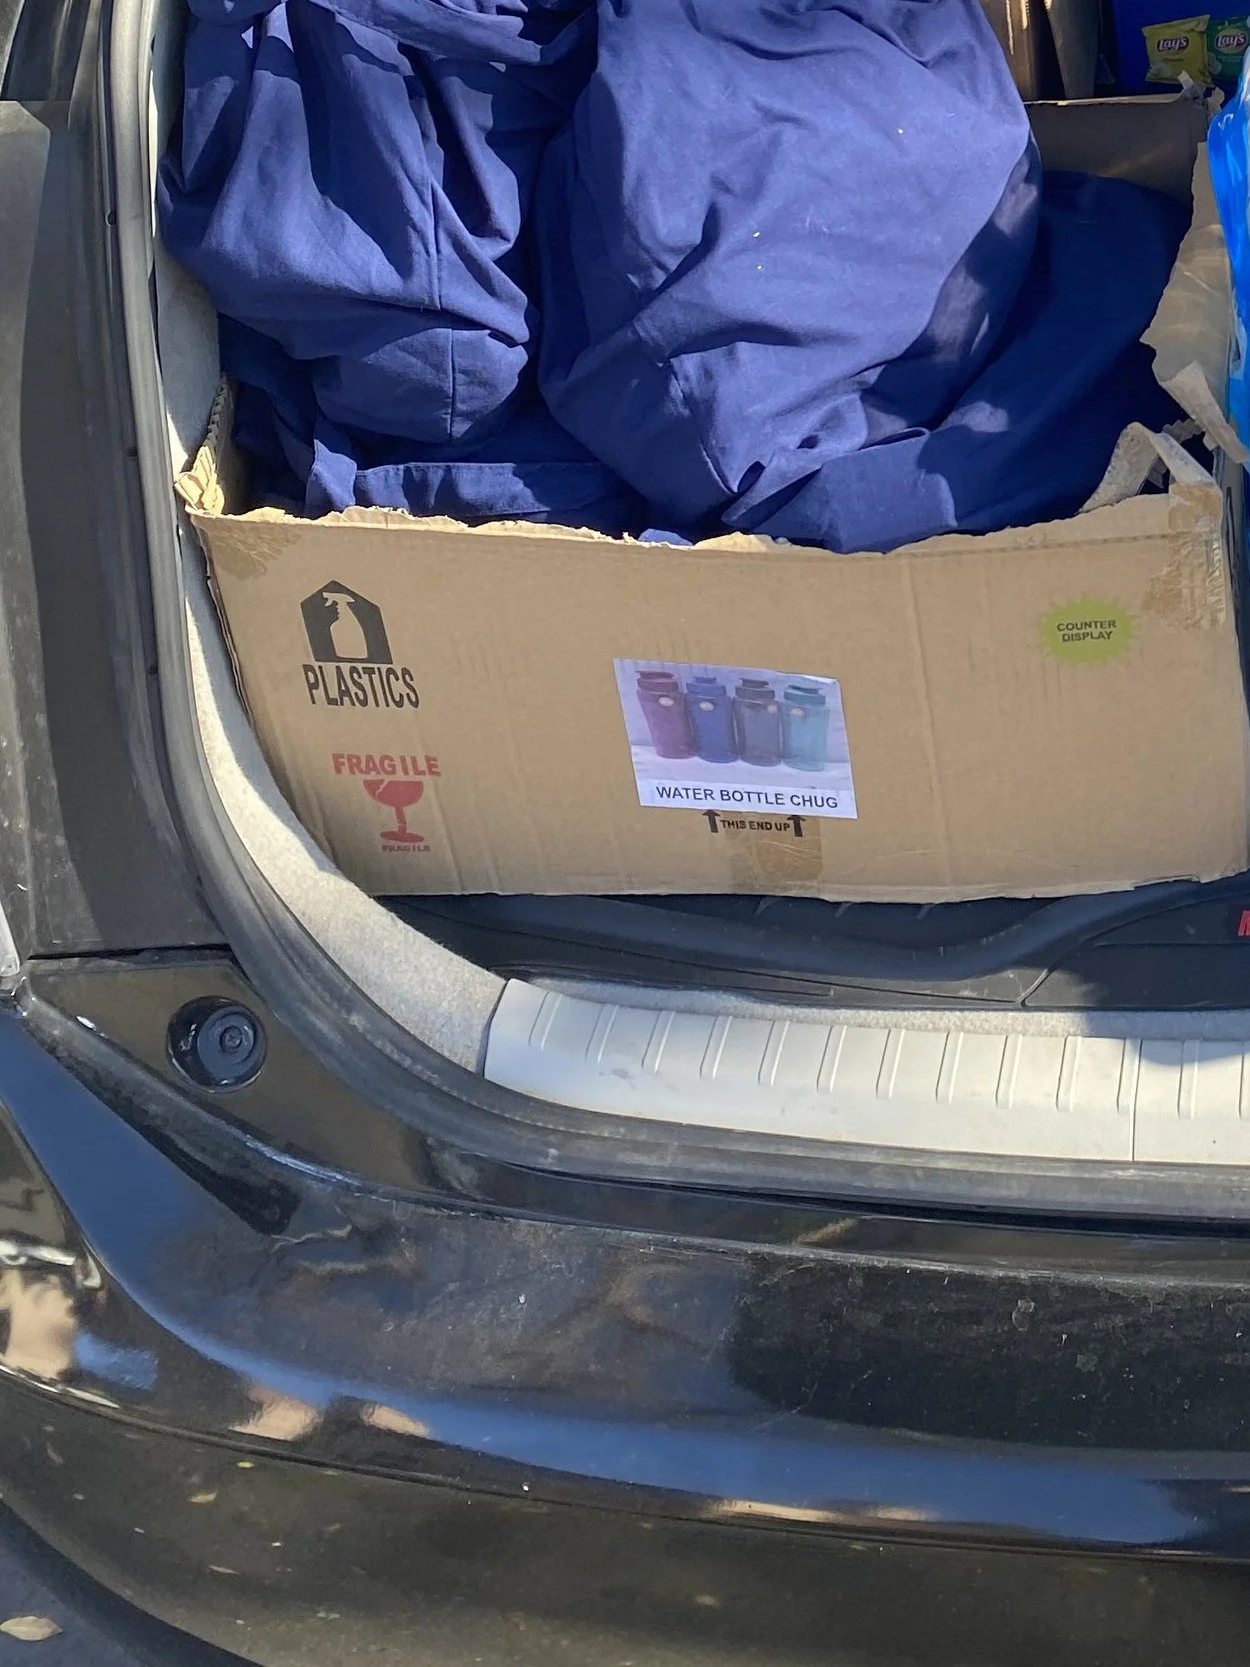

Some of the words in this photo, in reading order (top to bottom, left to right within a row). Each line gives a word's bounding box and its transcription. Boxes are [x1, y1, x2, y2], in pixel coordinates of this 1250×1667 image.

[1057, 620, 1117, 632] COUNTER
[1062, 631, 1113, 643] DISPLAY
[302, 664, 420, 709] PLASTICS
[332, 753, 442, 777] FRAGILE
[656, 786, 715, 801] WATER
[720, 789, 785, 806] BOTTLE
[790, 794, 838, 808] CHUG
[720, 819, 747, 830] THIS
[750, 820, 772, 831] END
[774, 822, 791, 832] UP
